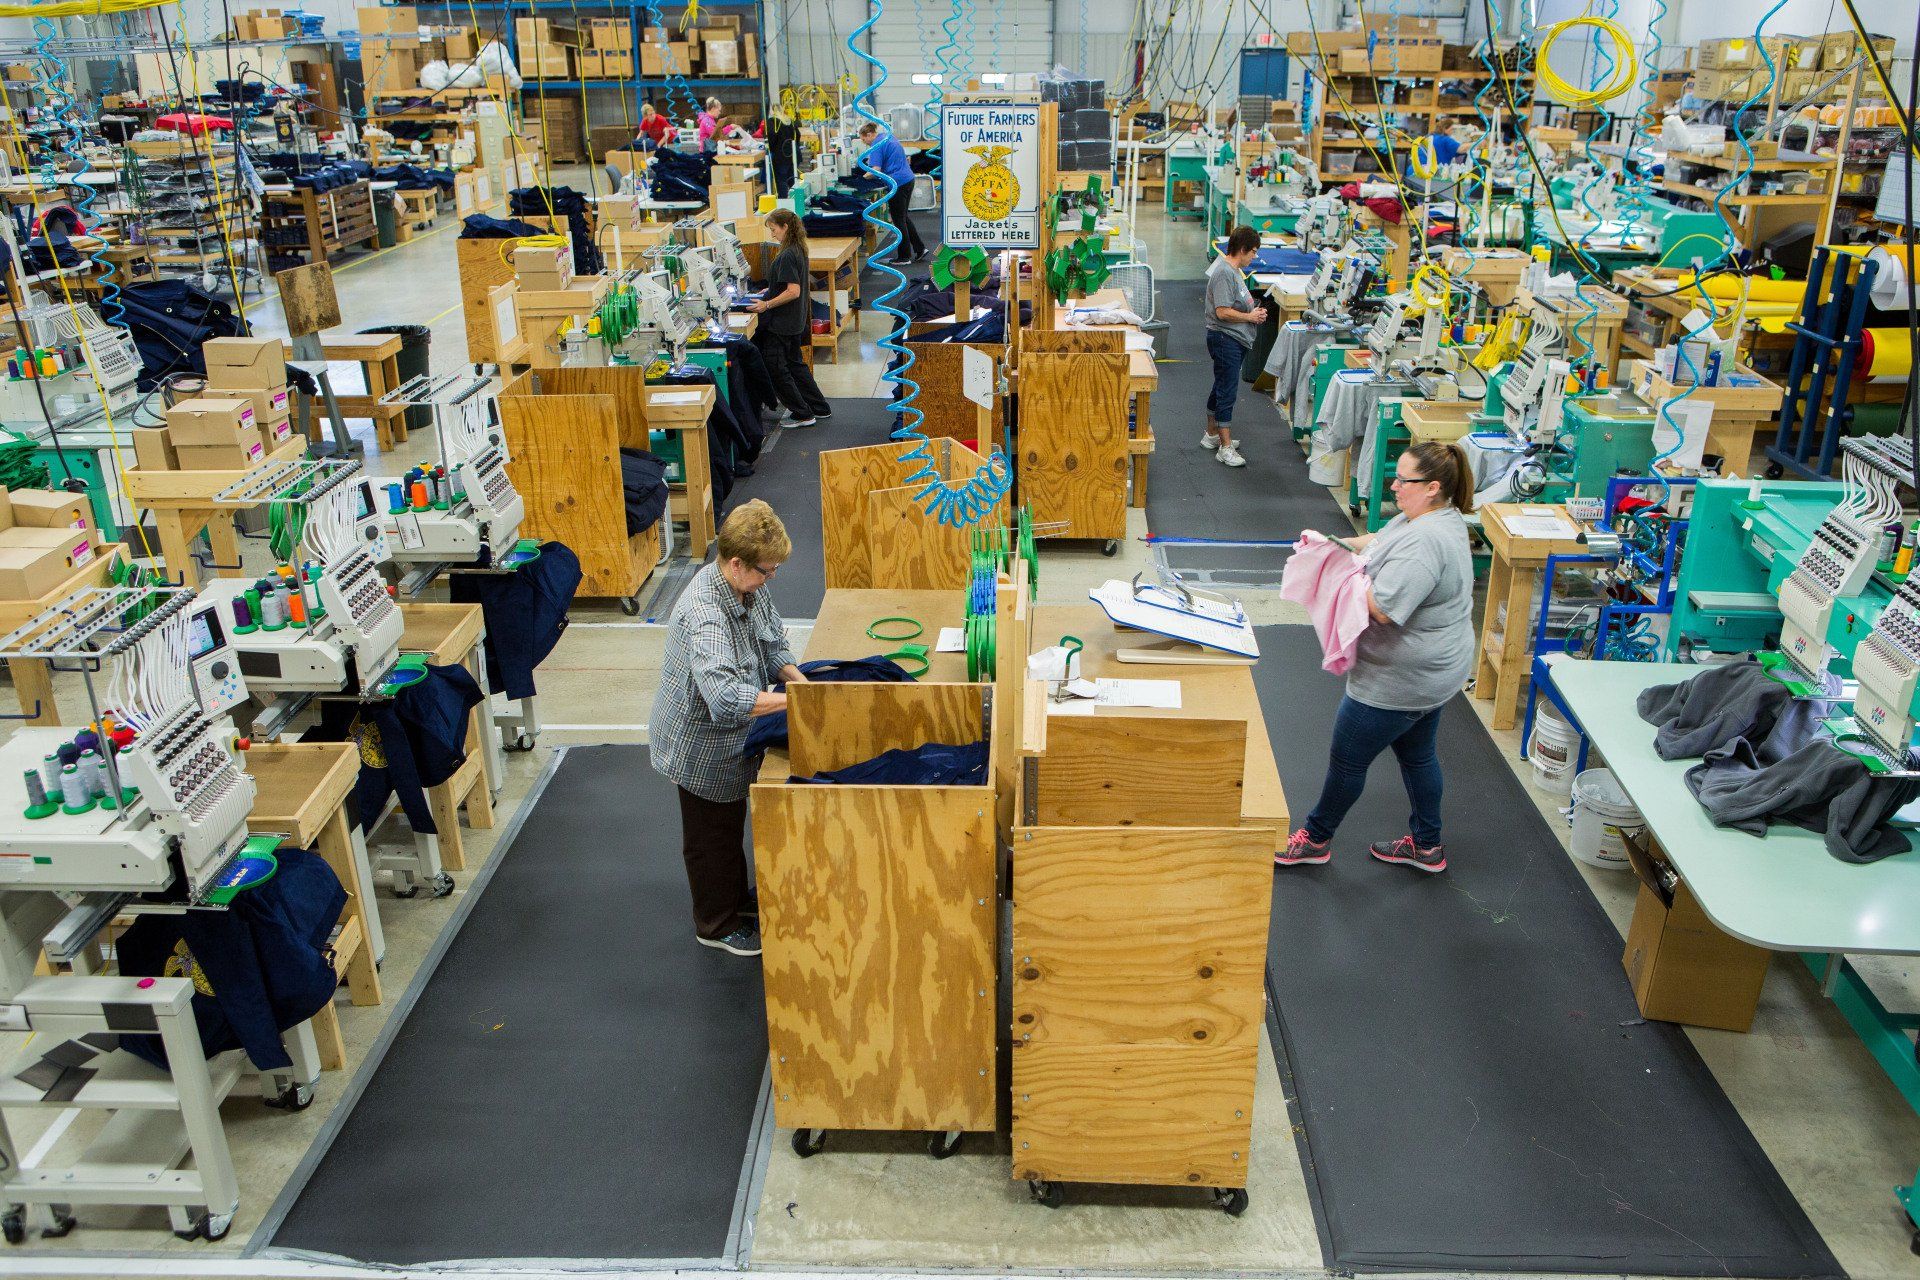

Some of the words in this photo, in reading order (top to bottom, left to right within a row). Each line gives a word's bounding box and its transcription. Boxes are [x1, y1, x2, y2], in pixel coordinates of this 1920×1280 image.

[948, 111, 984, 126] FUTURE
[989, 111, 1036, 126] FARMERS
[960, 131, 973, 143] OF
[977, 128, 1023, 143] AMERICA
[981, 180, 1003, 190] FFA
[965, 219, 1018, 229] Jackets
[951, 230, 996, 240] LETTERED
[1002, 231, 1030, 240] HERE
